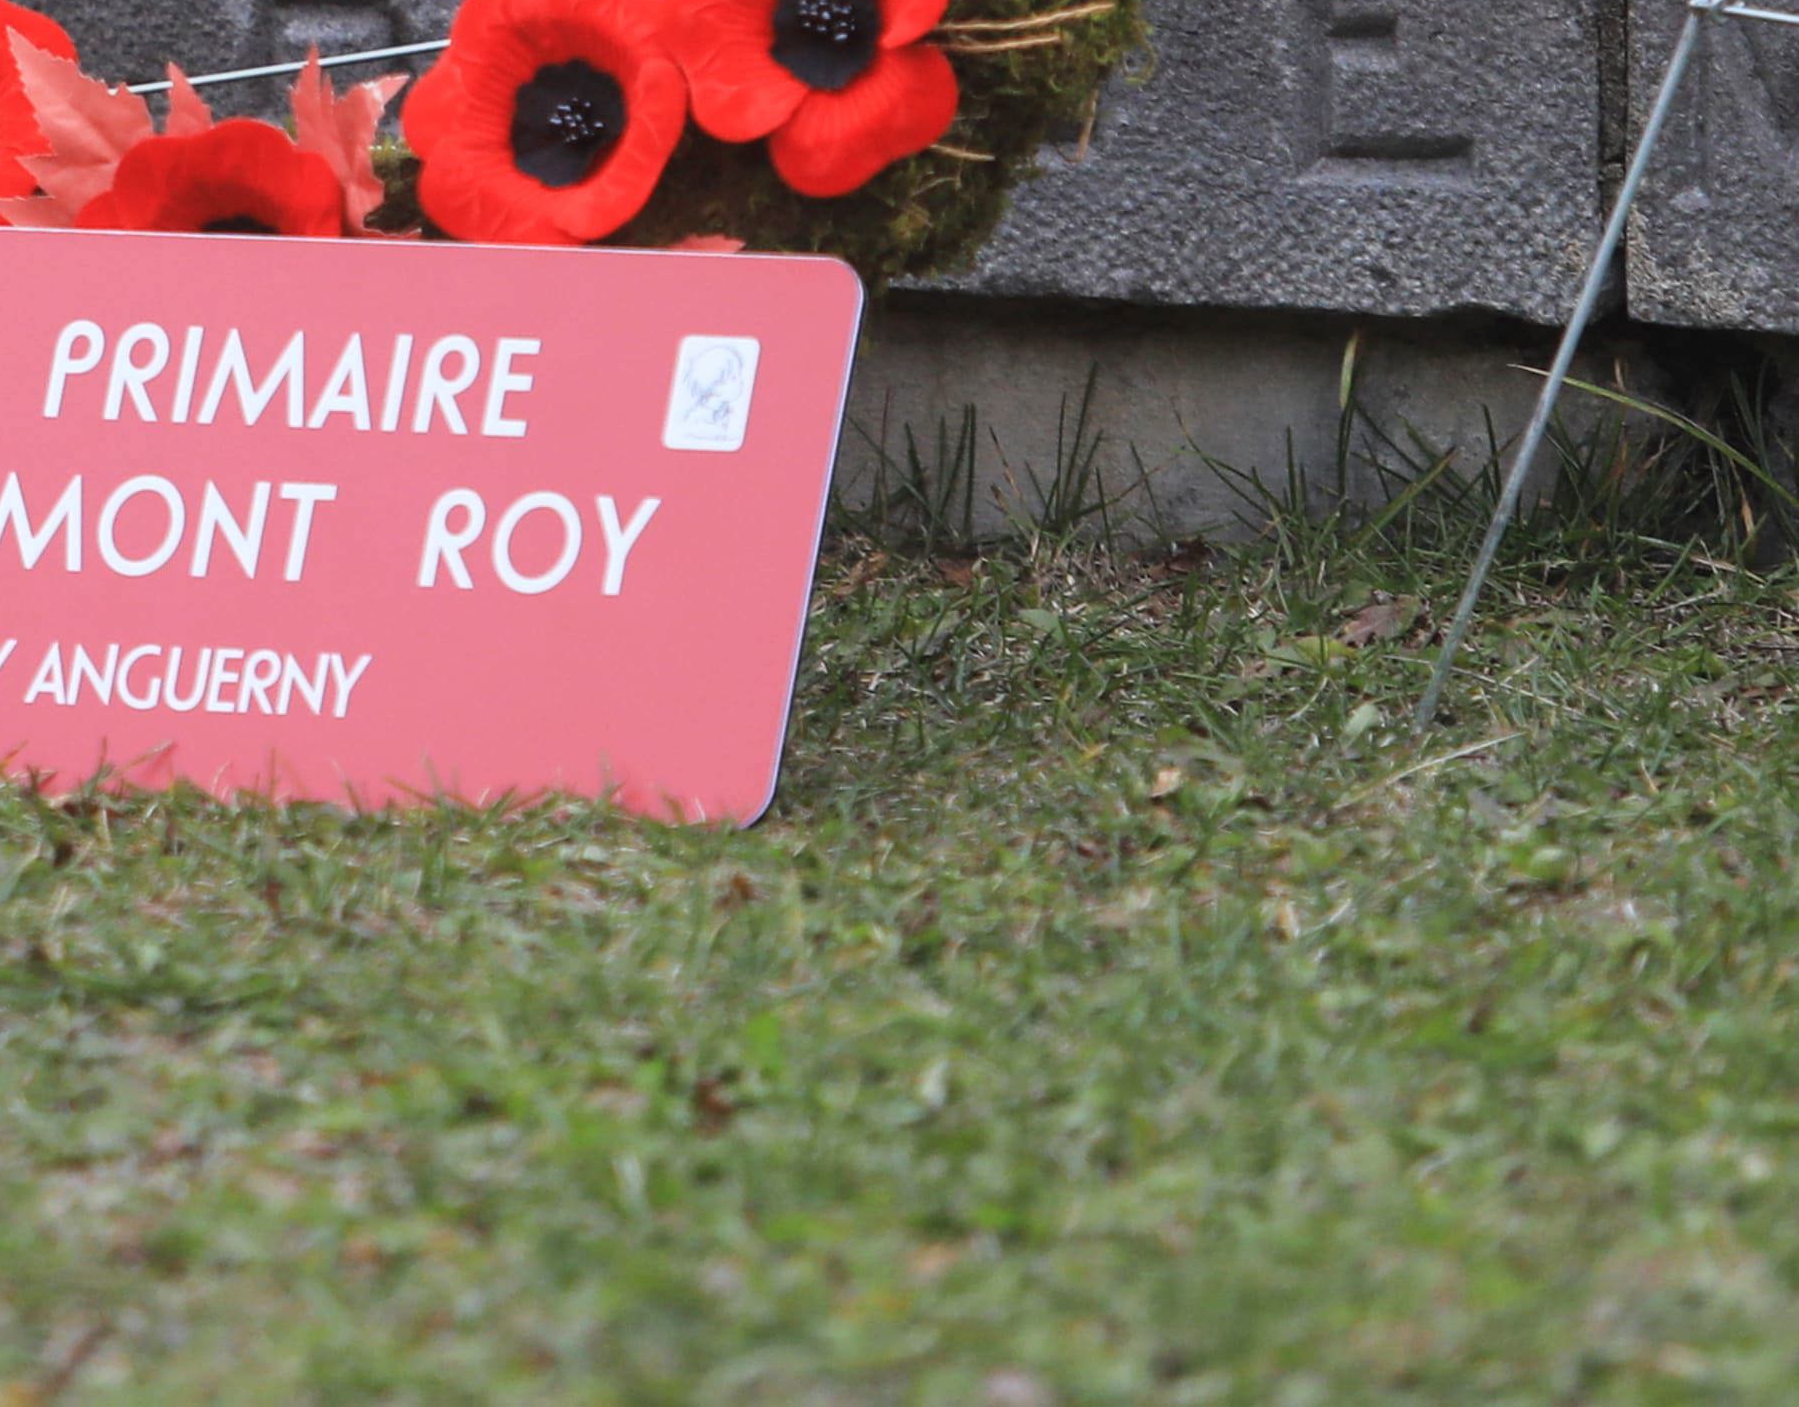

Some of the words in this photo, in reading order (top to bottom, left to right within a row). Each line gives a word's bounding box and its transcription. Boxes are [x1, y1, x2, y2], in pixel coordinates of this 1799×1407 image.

[42, 318, 542, 438] PRIMAIRE
[417, 487, 662, 597] ROY
[23, 641, 373, 719] ANGUERNY
